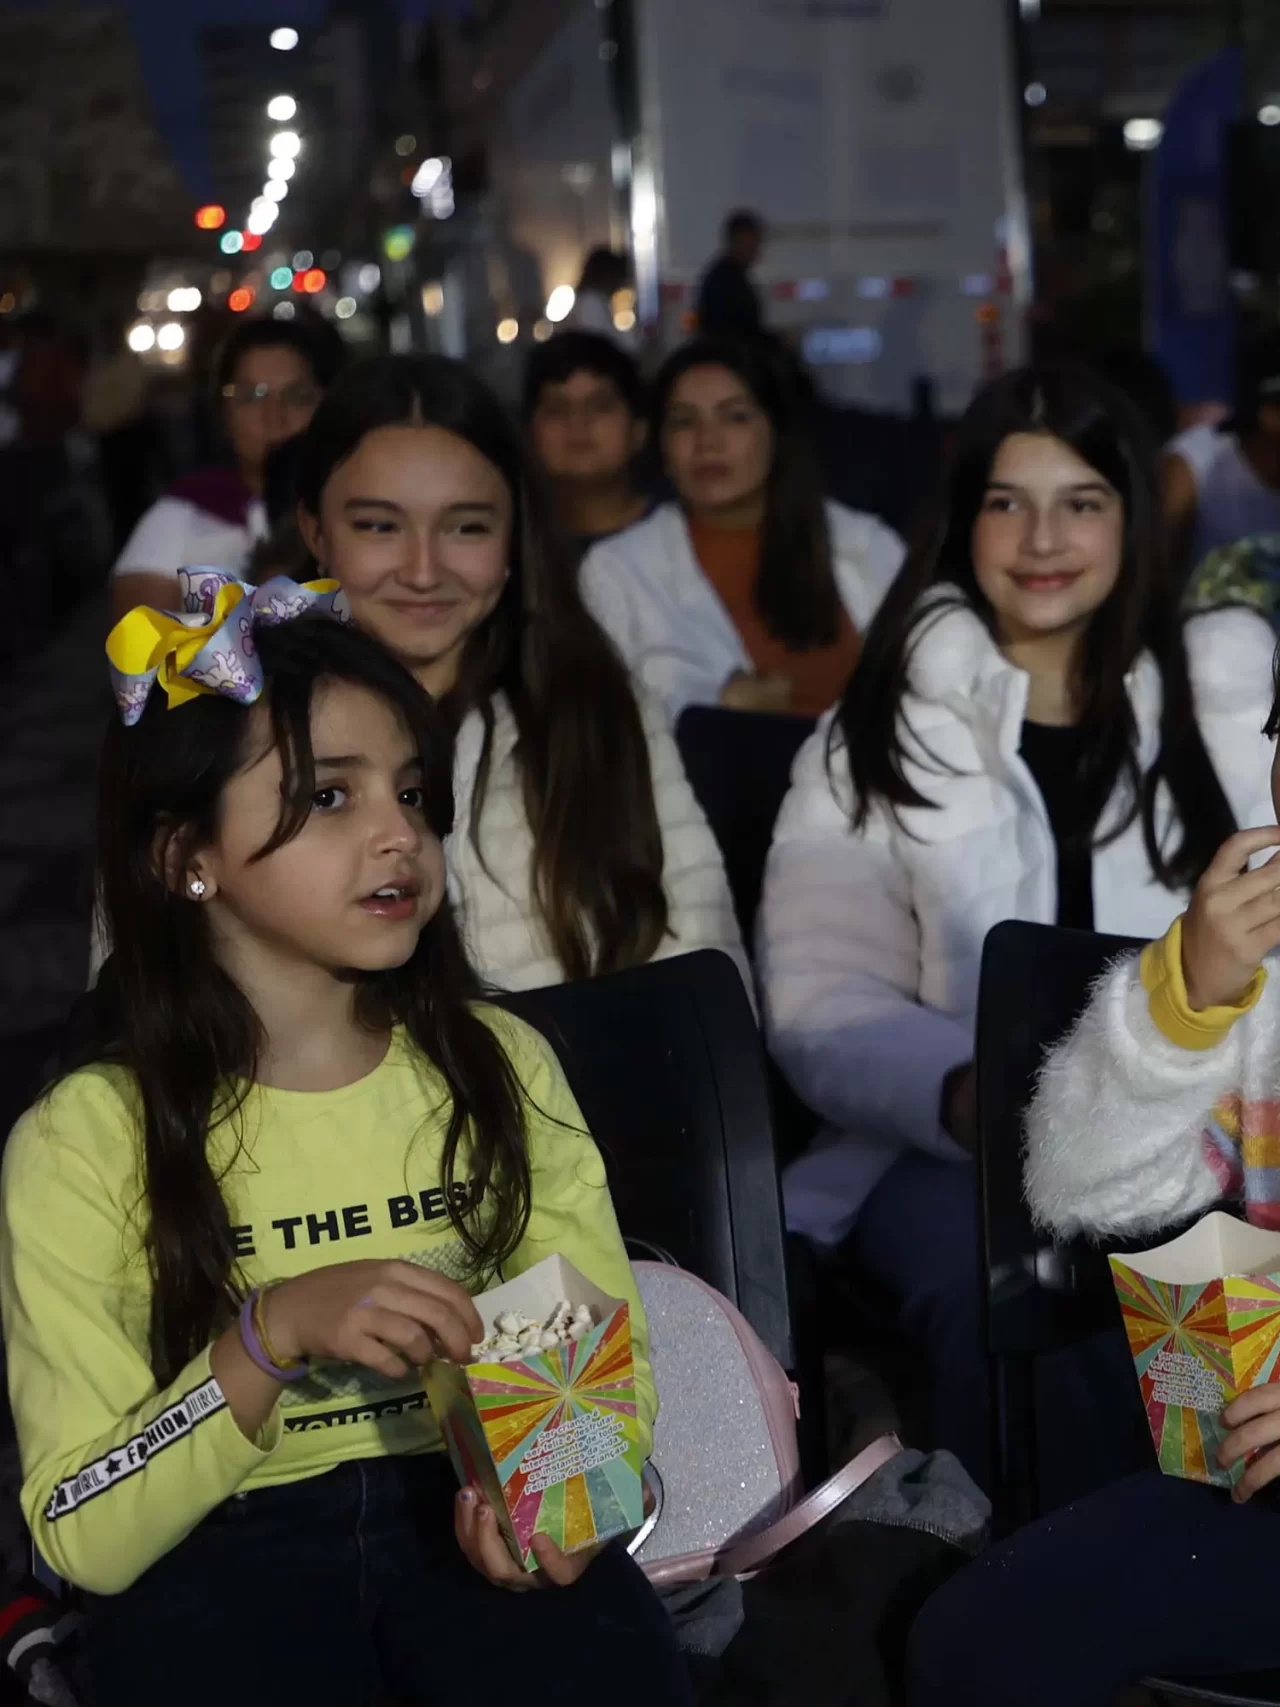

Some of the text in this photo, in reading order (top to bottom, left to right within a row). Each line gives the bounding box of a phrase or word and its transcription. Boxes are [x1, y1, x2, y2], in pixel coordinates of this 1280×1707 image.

[229, 1181, 478, 1257] E THE BES
[521, 1442, 583, 1472] intensamente
[599, 1423, 623, 1438] todos
[526, 1447, 540, 1456] ser
[544, 1438, 563, 1450] feliz
[574, 1415, 614, 1437] desfrutar
[539, 1431, 554, 1441] Ser
[558, 1415, 591, 1432] criança
[526, 1443, 628, 1493] Feliz Dia das Crianças!
[543, 1454, 585, 1475] instantes
[601, 1437, 618, 1448] vida
